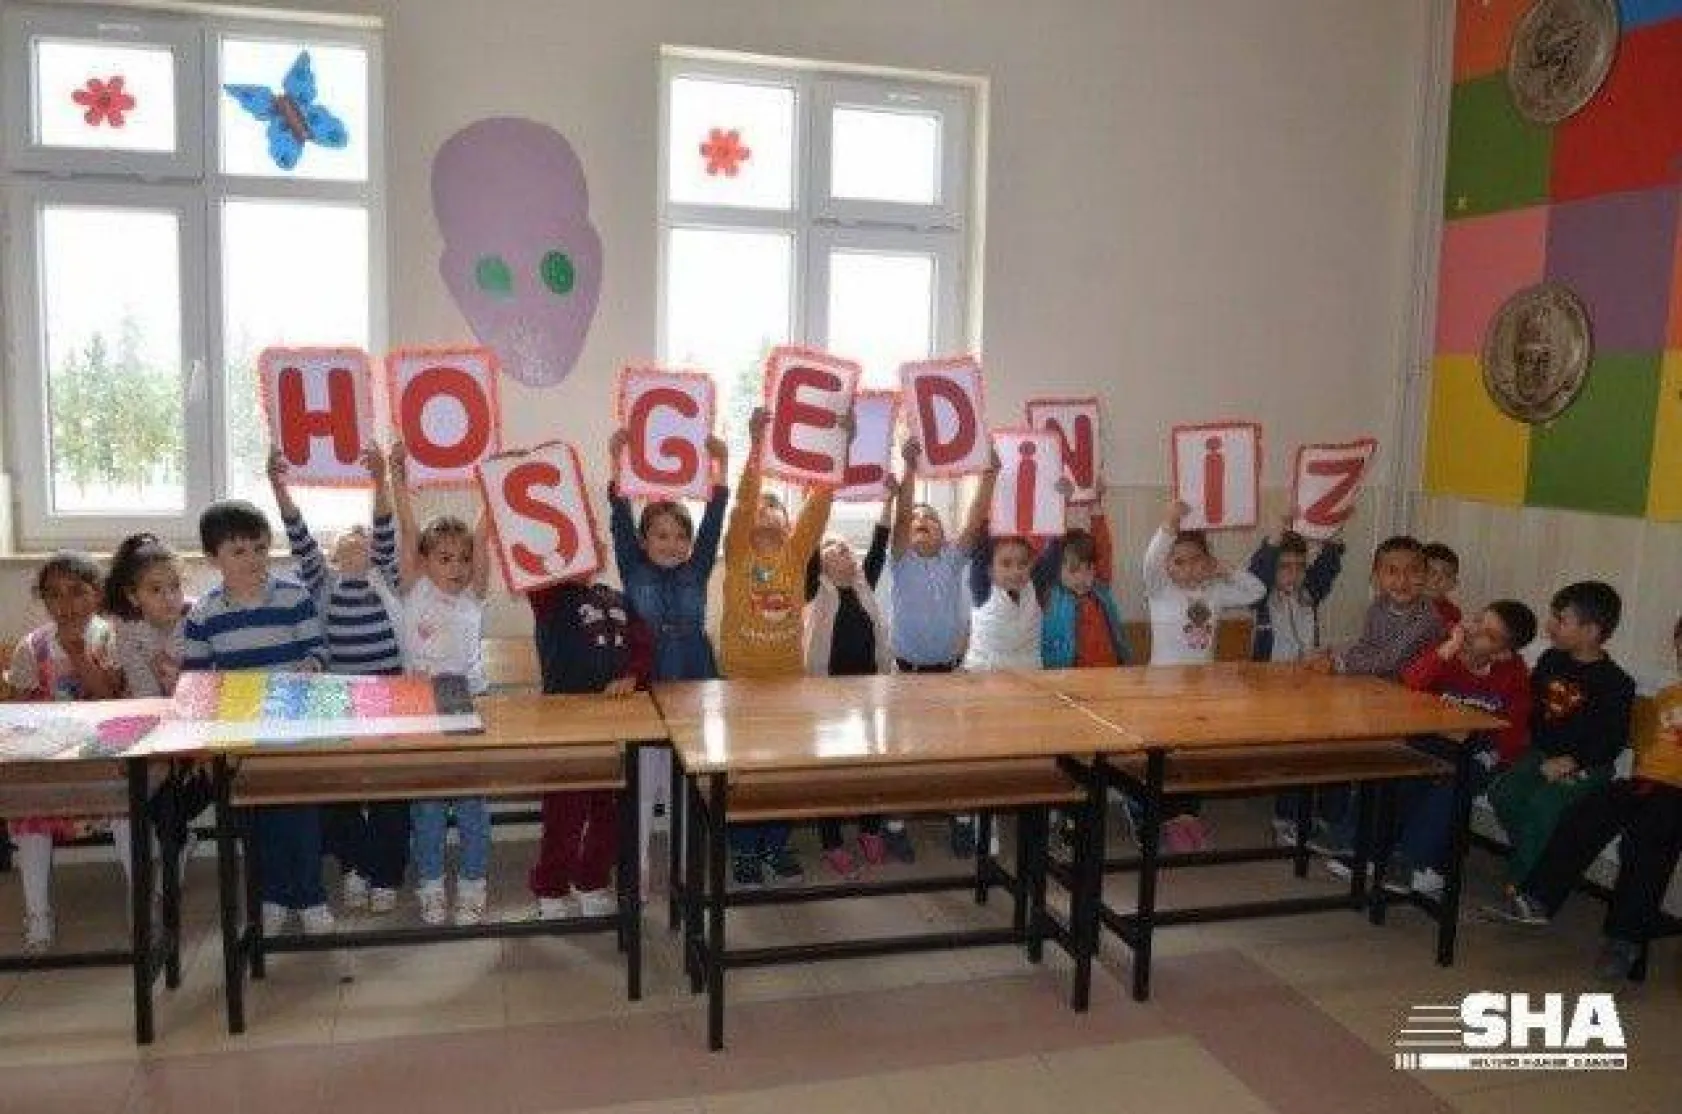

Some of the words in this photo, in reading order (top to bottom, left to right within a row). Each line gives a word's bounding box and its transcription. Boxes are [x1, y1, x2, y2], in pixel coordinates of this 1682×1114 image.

[278, 367, 359, 465] H
[400, 367, 490, 468] O
[628, 388, 699, 485] G
[773, 367, 841, 472] E
[915, 375, 976, 466] D
[1304, 457, 1366, 526] Z
